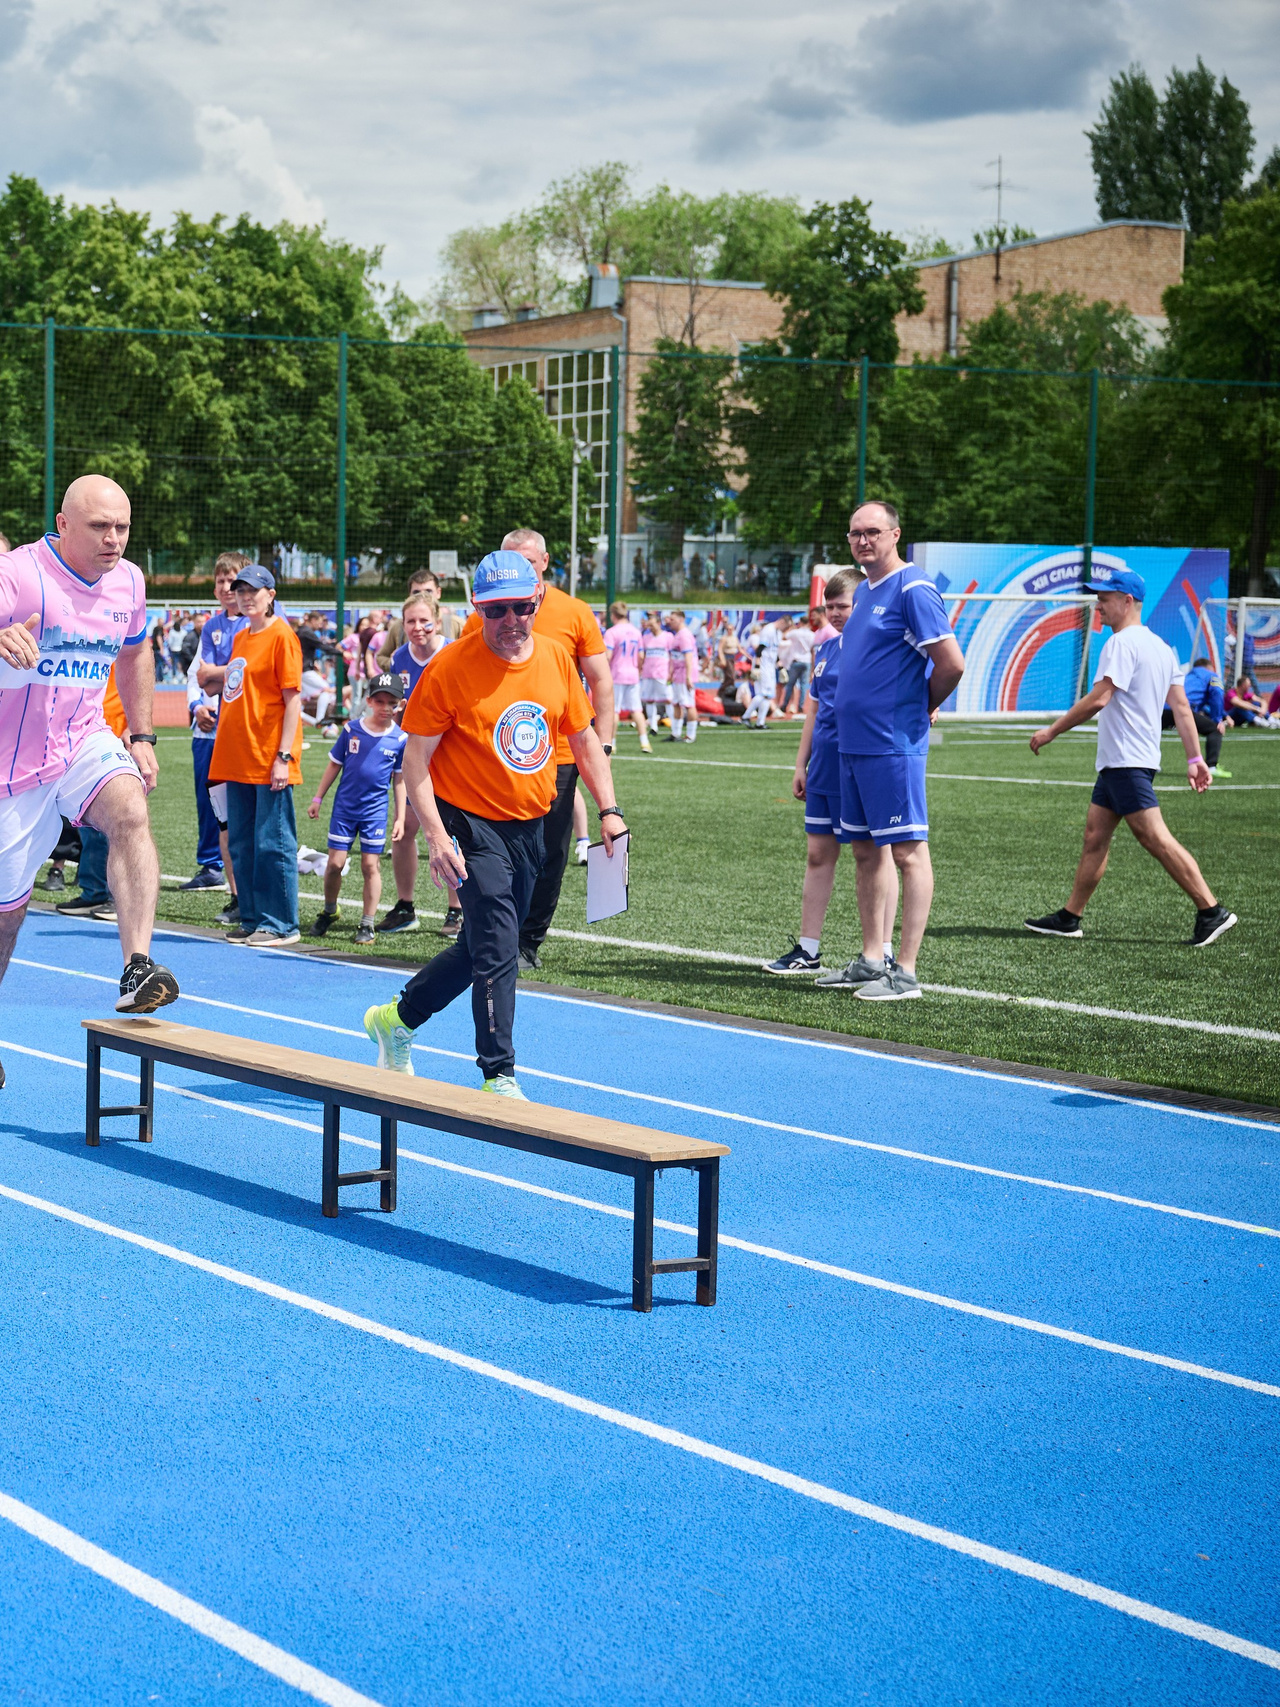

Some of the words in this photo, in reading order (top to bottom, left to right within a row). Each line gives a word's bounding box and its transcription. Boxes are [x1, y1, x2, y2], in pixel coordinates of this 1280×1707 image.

[486, 569, 519, 583] RUSSIA
[873, 606, 886, 614] ВТБ
[113, 612, 129, 623] ВТБ
[620, 640, 638, 656] 17
[521, 733, 534, 741] ВТБ
[115, 752, 133, 764] ВТ
[889, 815, 902, 824] FN
